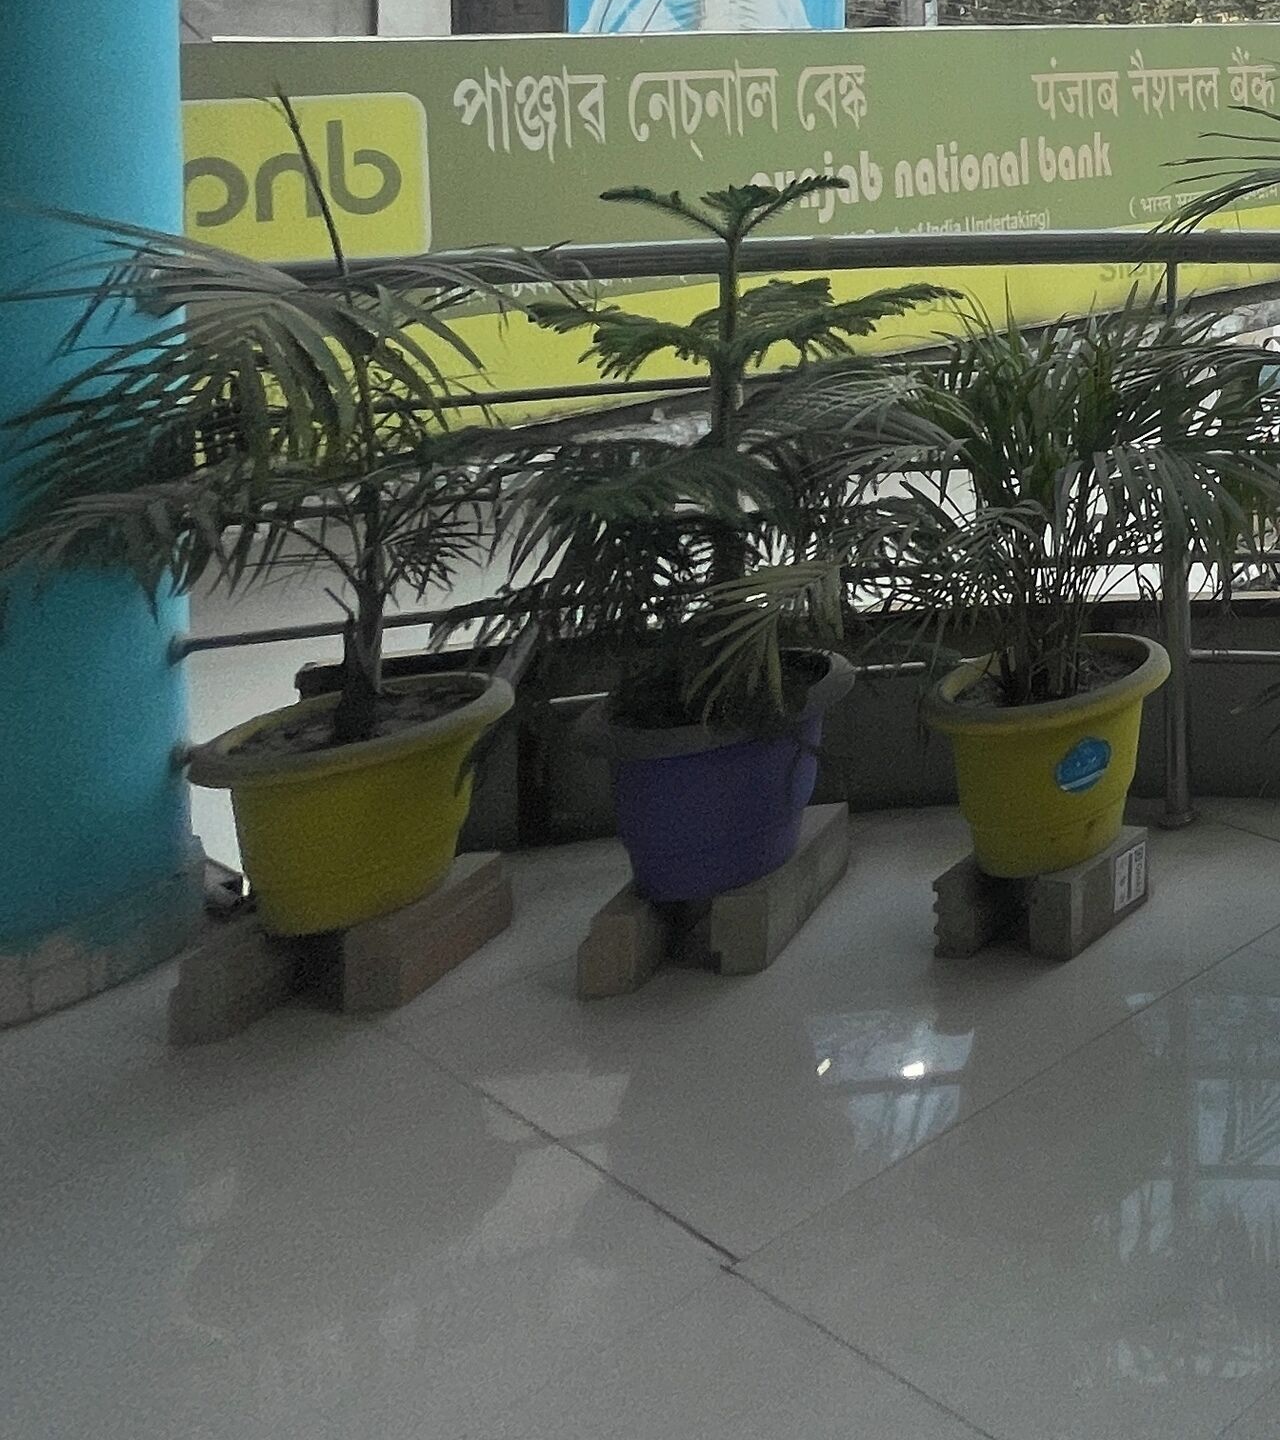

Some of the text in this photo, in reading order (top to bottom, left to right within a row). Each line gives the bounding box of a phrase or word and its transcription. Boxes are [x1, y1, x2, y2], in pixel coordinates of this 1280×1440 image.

[1031, 46, 1276, 120] पंजाब नैशनल बैंक
[183, 119, 403, 228] pnb
[895, 136, 1030, 199] national
[1037, 131, 1113, 183] bank
[964, 208, 1051, 234] Undertaking)
